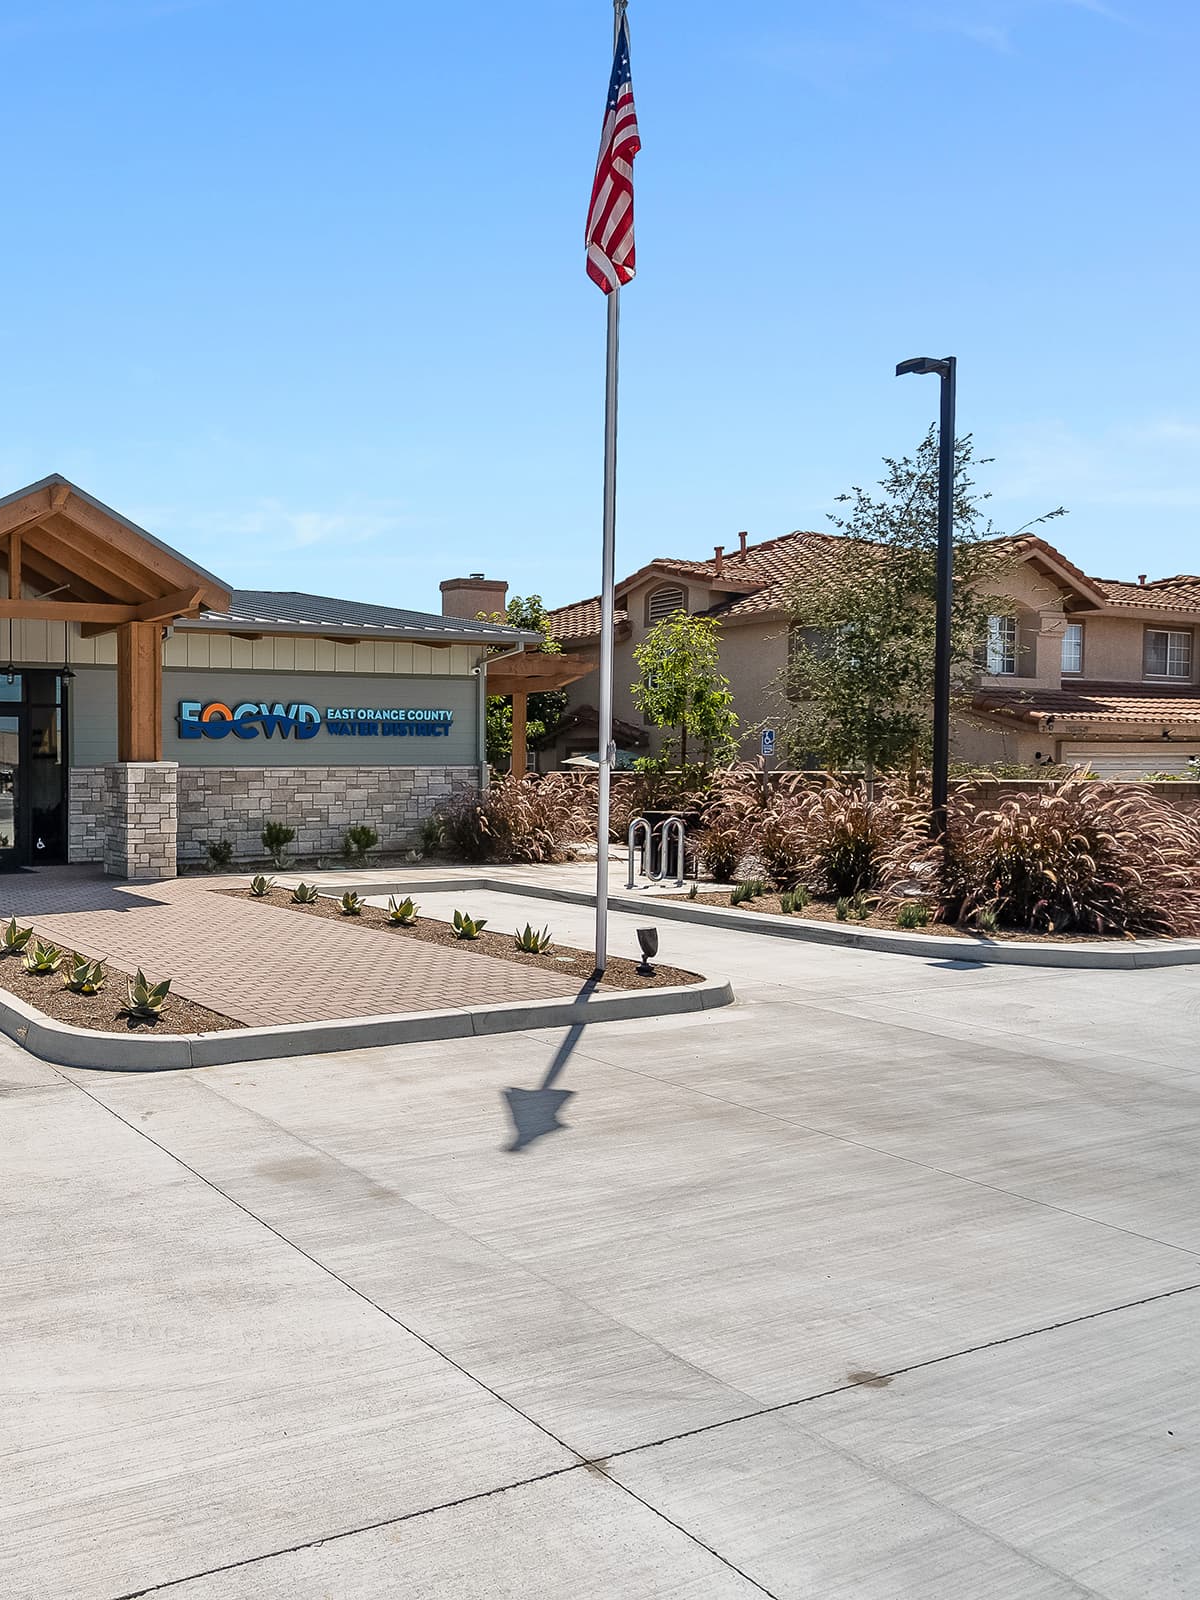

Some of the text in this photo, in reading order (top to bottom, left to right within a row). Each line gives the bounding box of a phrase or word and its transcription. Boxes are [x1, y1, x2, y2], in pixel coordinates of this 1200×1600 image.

[179, 701, 321, 739] EOCWD
[326, 708, 453, 721] EAST ORANGE COUNTY
[327, 721, 452, 737] WATER DISTRICT
